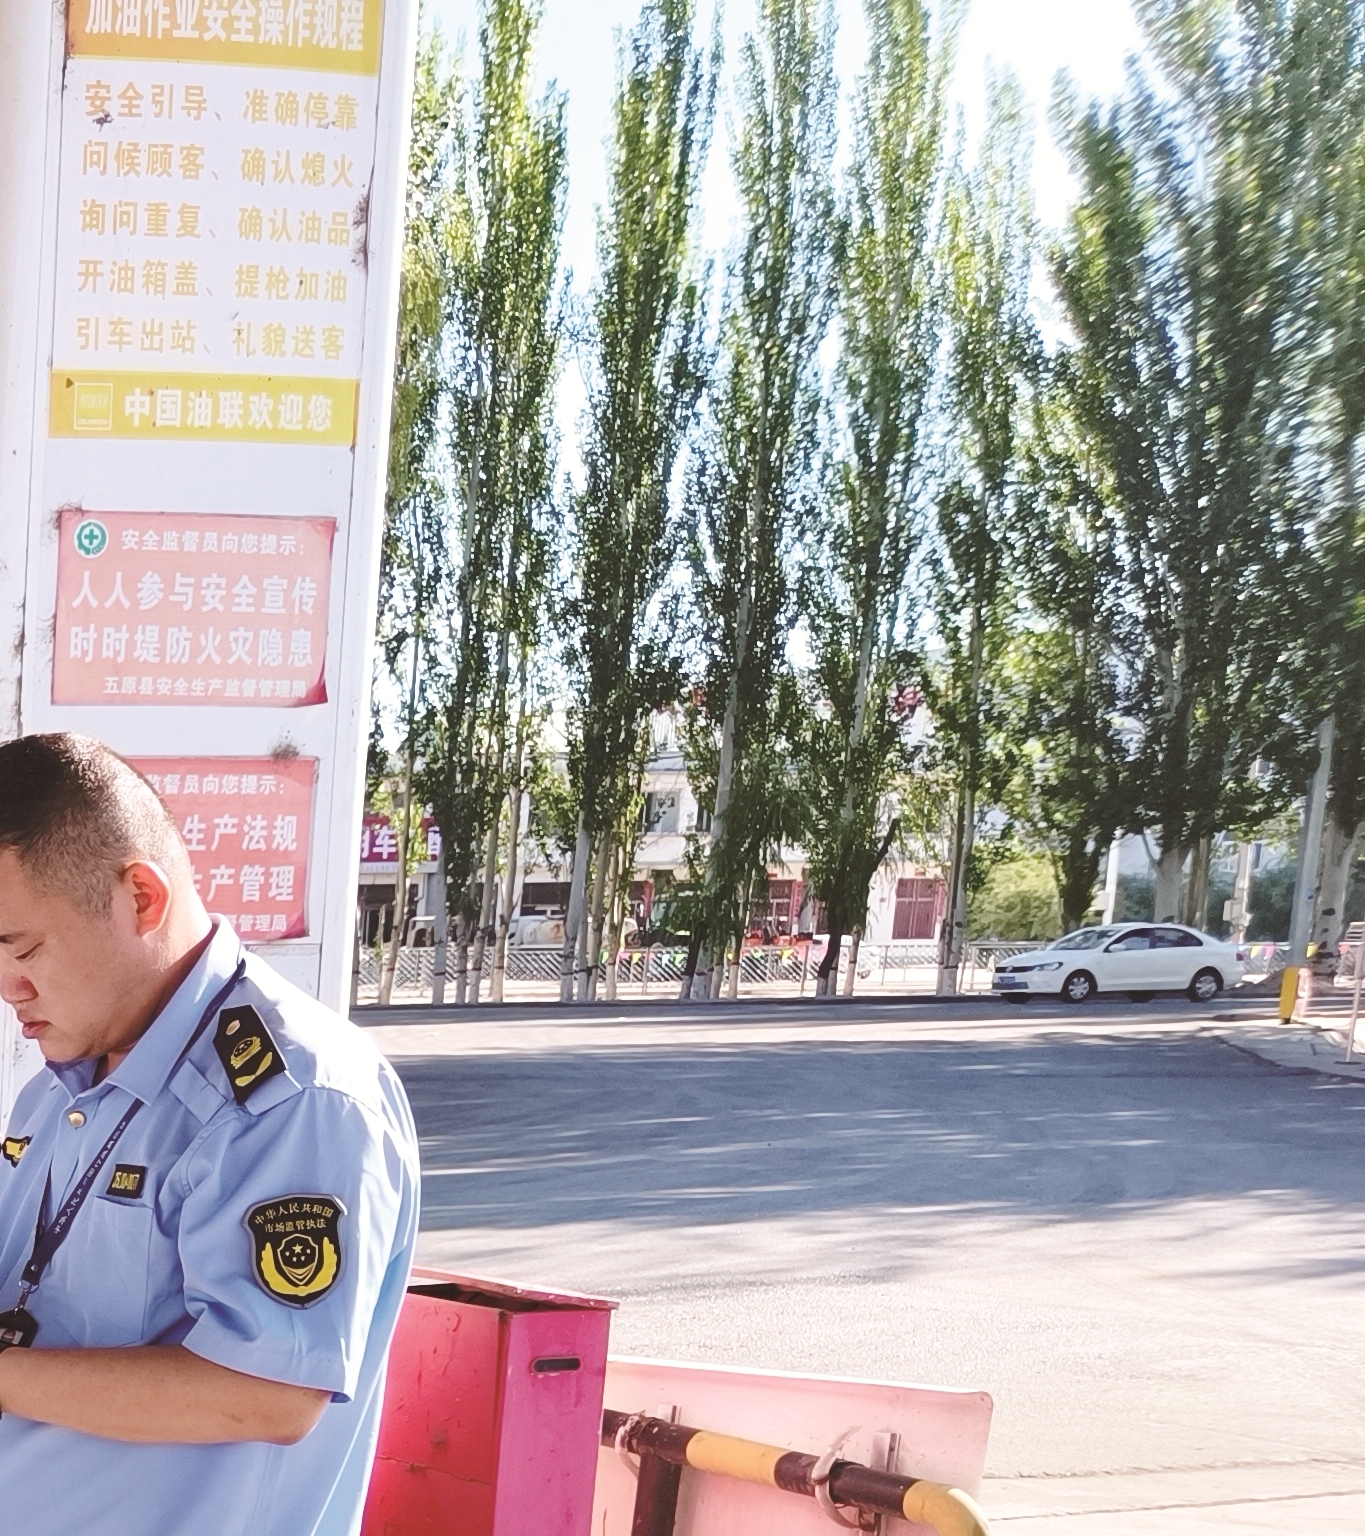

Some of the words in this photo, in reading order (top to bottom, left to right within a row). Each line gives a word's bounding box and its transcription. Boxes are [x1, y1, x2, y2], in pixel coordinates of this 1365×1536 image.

[85, 0, 364, 51] 加油作业安全操作规程
[85, 80, 359, 131] 安全引导、准确停靠
[82, 140, 354, 189] 问候顾客、确认熄火
[80, 199, 351, 247] 询问重复、确认油品
[77, 258, 349, 304] 开油箱盖、提枪加油
[76, 316, 345, 360] 引车出站、礼貌送客
[124, 387, 333, 431] 中国油联欢迎您
[121, 528, 305, 556] 安全监督员向您提示：
[71, 570, 318, 616] 人人参与安全宣传
[69, 623, 313, 668] 时时堤防火灾隐患
[103, 676, 307, 699] 五原县安全生产监督管理局
[182, 813, 298, 851] 生产法规
[254, 1202, 335, 1225] 中华人民共和国
[264, 1218, 327, 1233] 市场监管执法
